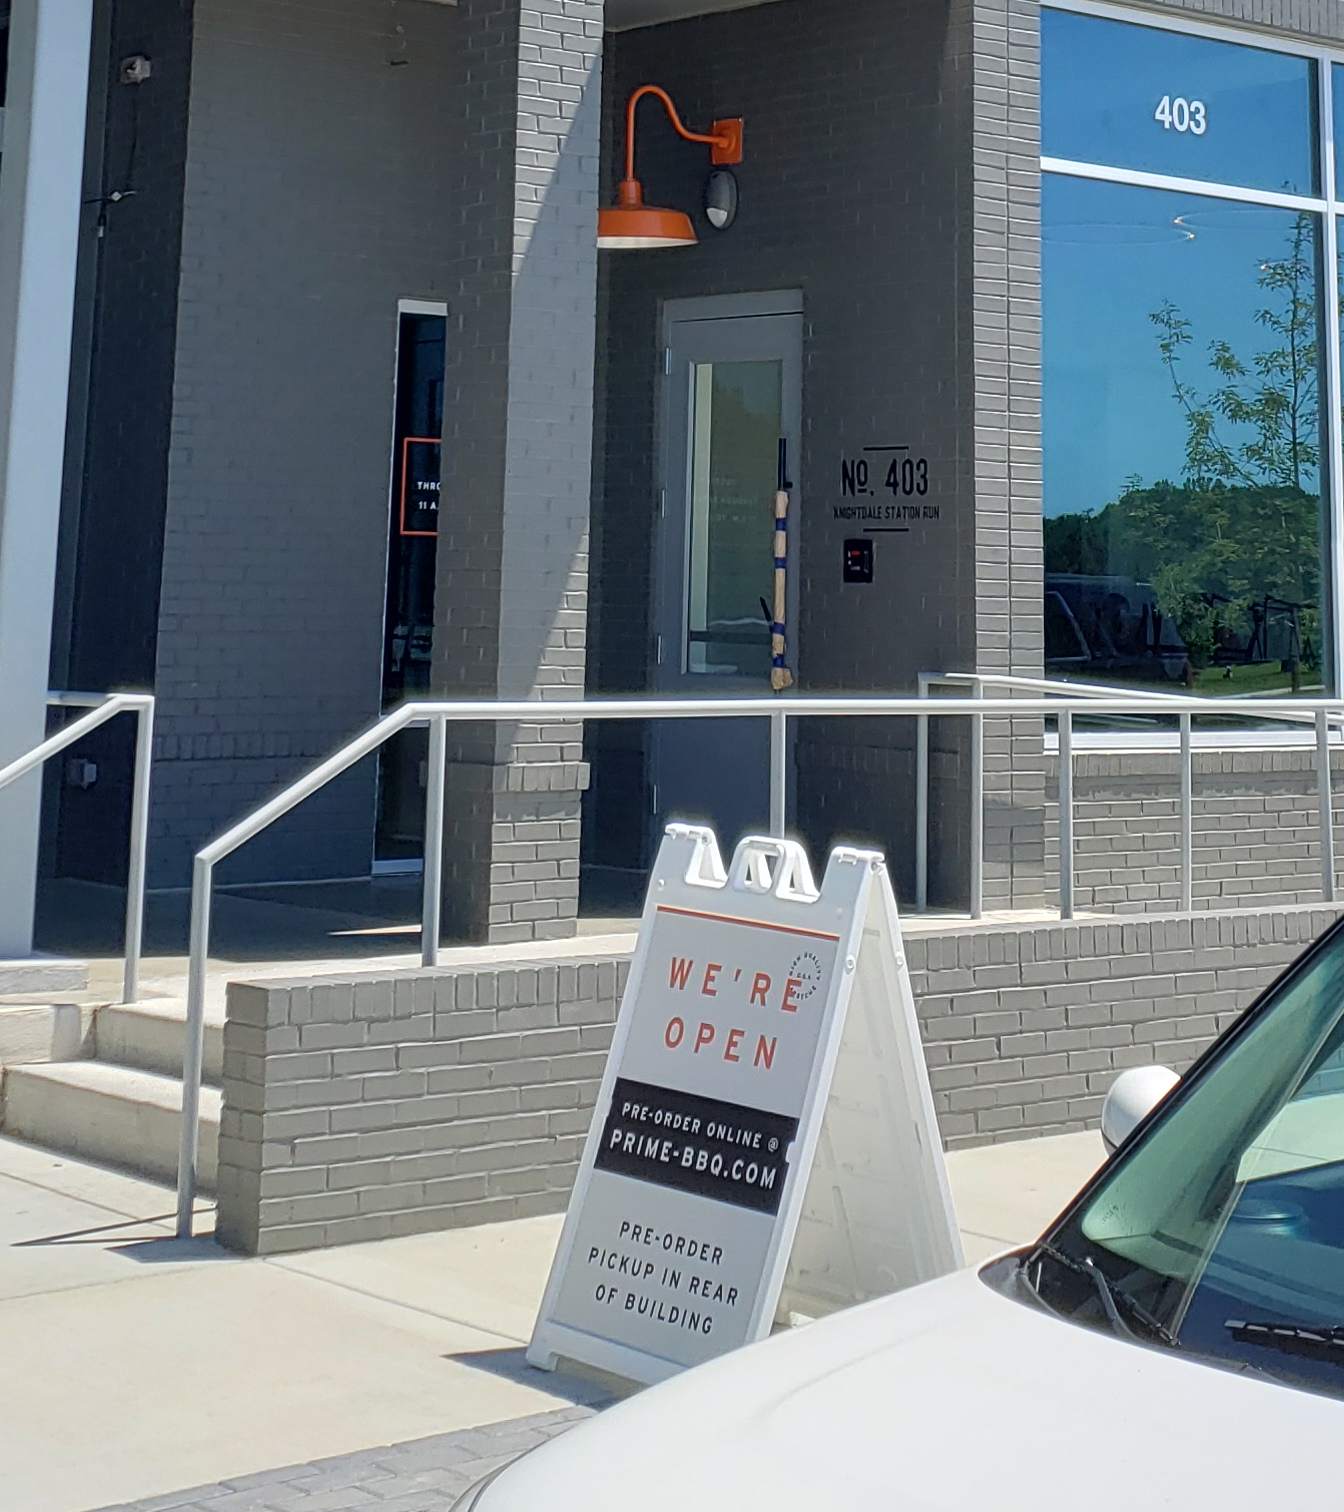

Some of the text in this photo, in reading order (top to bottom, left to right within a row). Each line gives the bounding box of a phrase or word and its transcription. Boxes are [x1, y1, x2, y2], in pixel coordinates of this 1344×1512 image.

[1154, 95, 1207, 135] 403
[885, 457, 929, 497] 403
[833, 505, 940, 520] KNIGHTDALE STATION RUN
[668, 956, 804, 1014] WE'RE
[664, 1016, 778, 1071] OPEN
[621, 1102, 779, 1153] PRE-ORDER ONLINE @
[609, 1128, 778, 1191] PRIME-BBQ.COM
[619, 1221, 724, 1266] PRE-ORDER
[588, 1246, 739, 1307] PICKUP IN REAR
[594, 1284, 713, 1335] OF BUILDING
